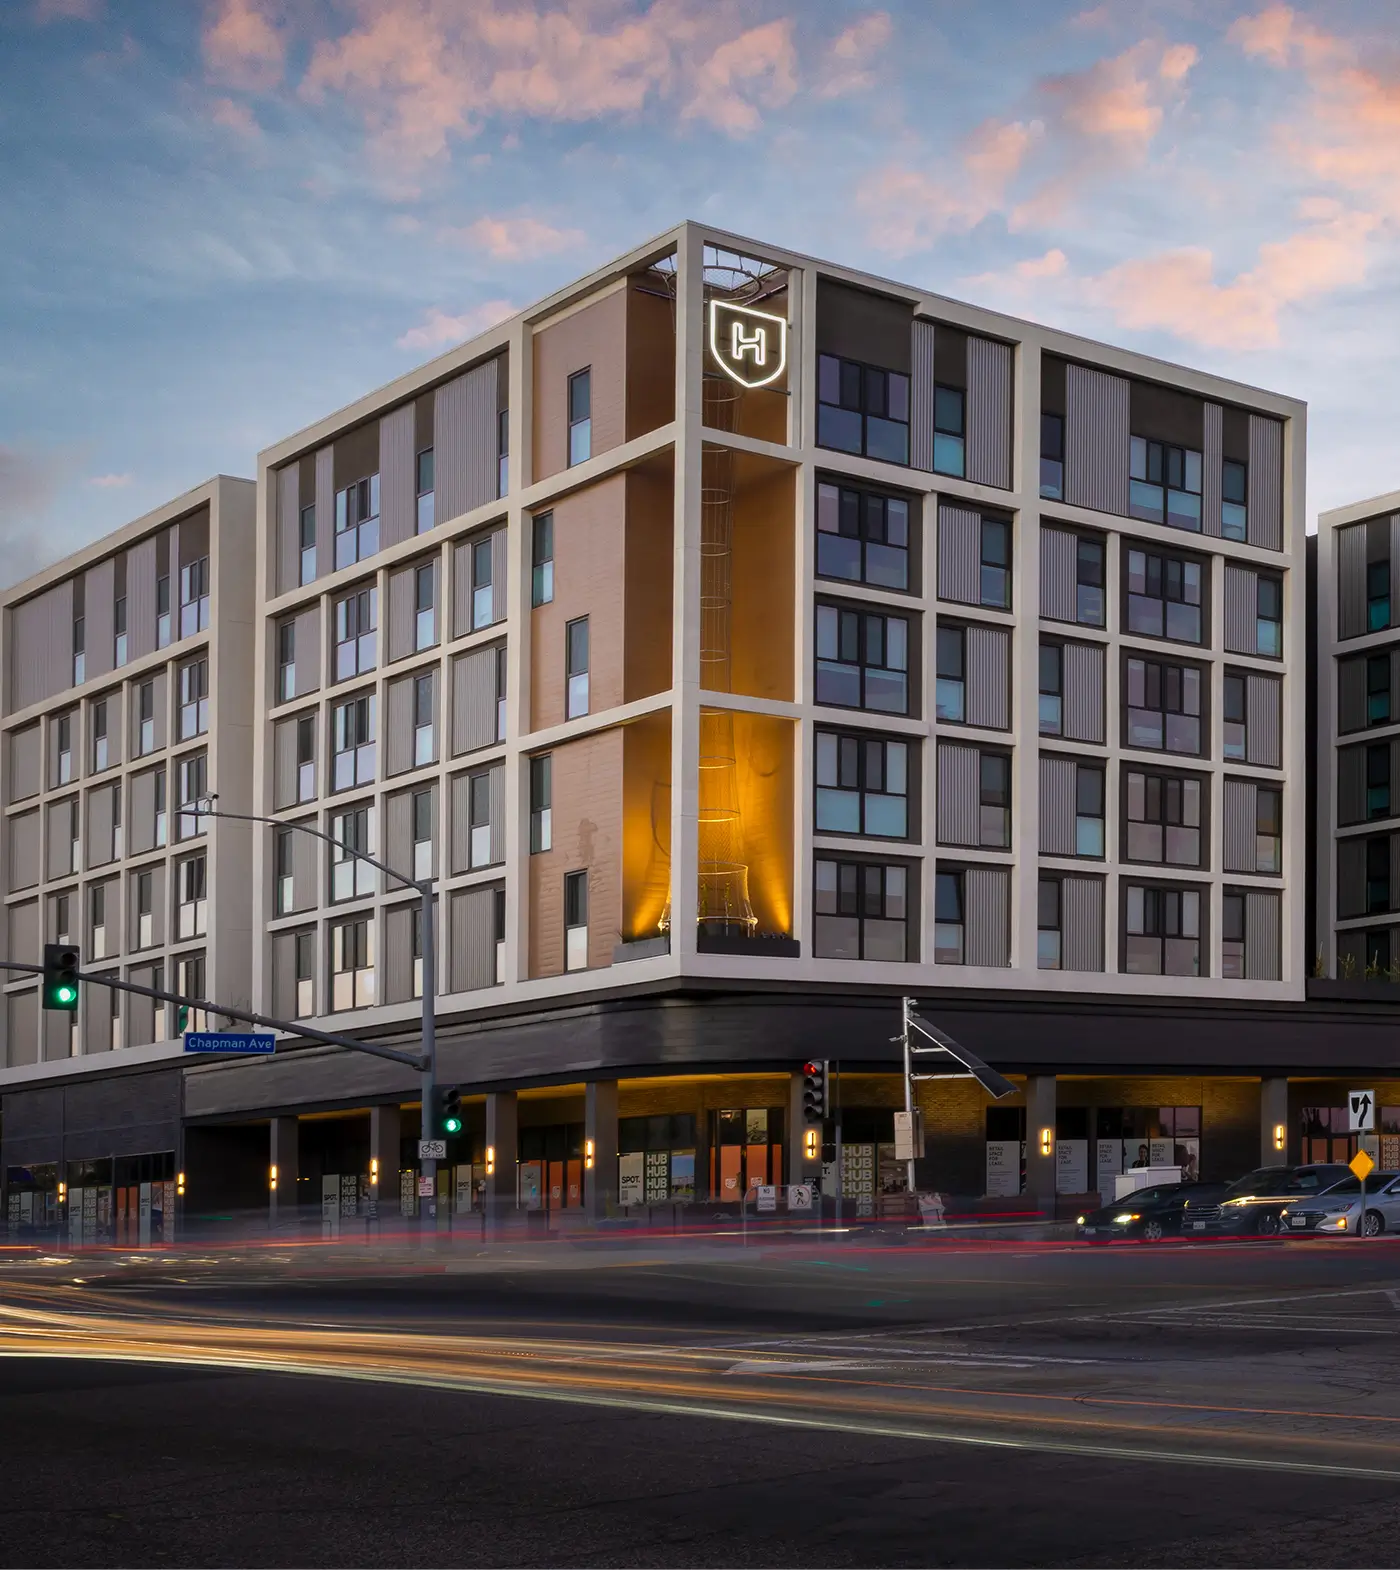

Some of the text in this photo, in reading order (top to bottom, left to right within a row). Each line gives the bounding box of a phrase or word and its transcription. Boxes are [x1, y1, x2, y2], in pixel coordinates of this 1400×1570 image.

[188, 1037, 272, 1050] Chapman Ave
[841, 1146, 873, 1157] HUB
[646, 1153, 668, 1165] HUB
[841, 1158, 873, 1169] HUB
[646, 1166, 668, 1177] HUB
[841, 1170, 873, 1181] HUB
[341, 1175, 357, 1185] HUB
[621, 1175, 640, 1184] SPOT.
[646, 1178, 668, 1189] HUB
[341, 1186, 357, 1195] HUB
[841, 1182, 873, 1193] HUB
[83, 1189, 97, 1198] HUB
[646, 1190, 668, 1201] HUB
[83, 1198, 97, 1207] HUB
[341, 1196, 357, 1205] HUB
[83, 1208, 97, 1217] HUB
[341, 1206, 357, 1216] HUB
